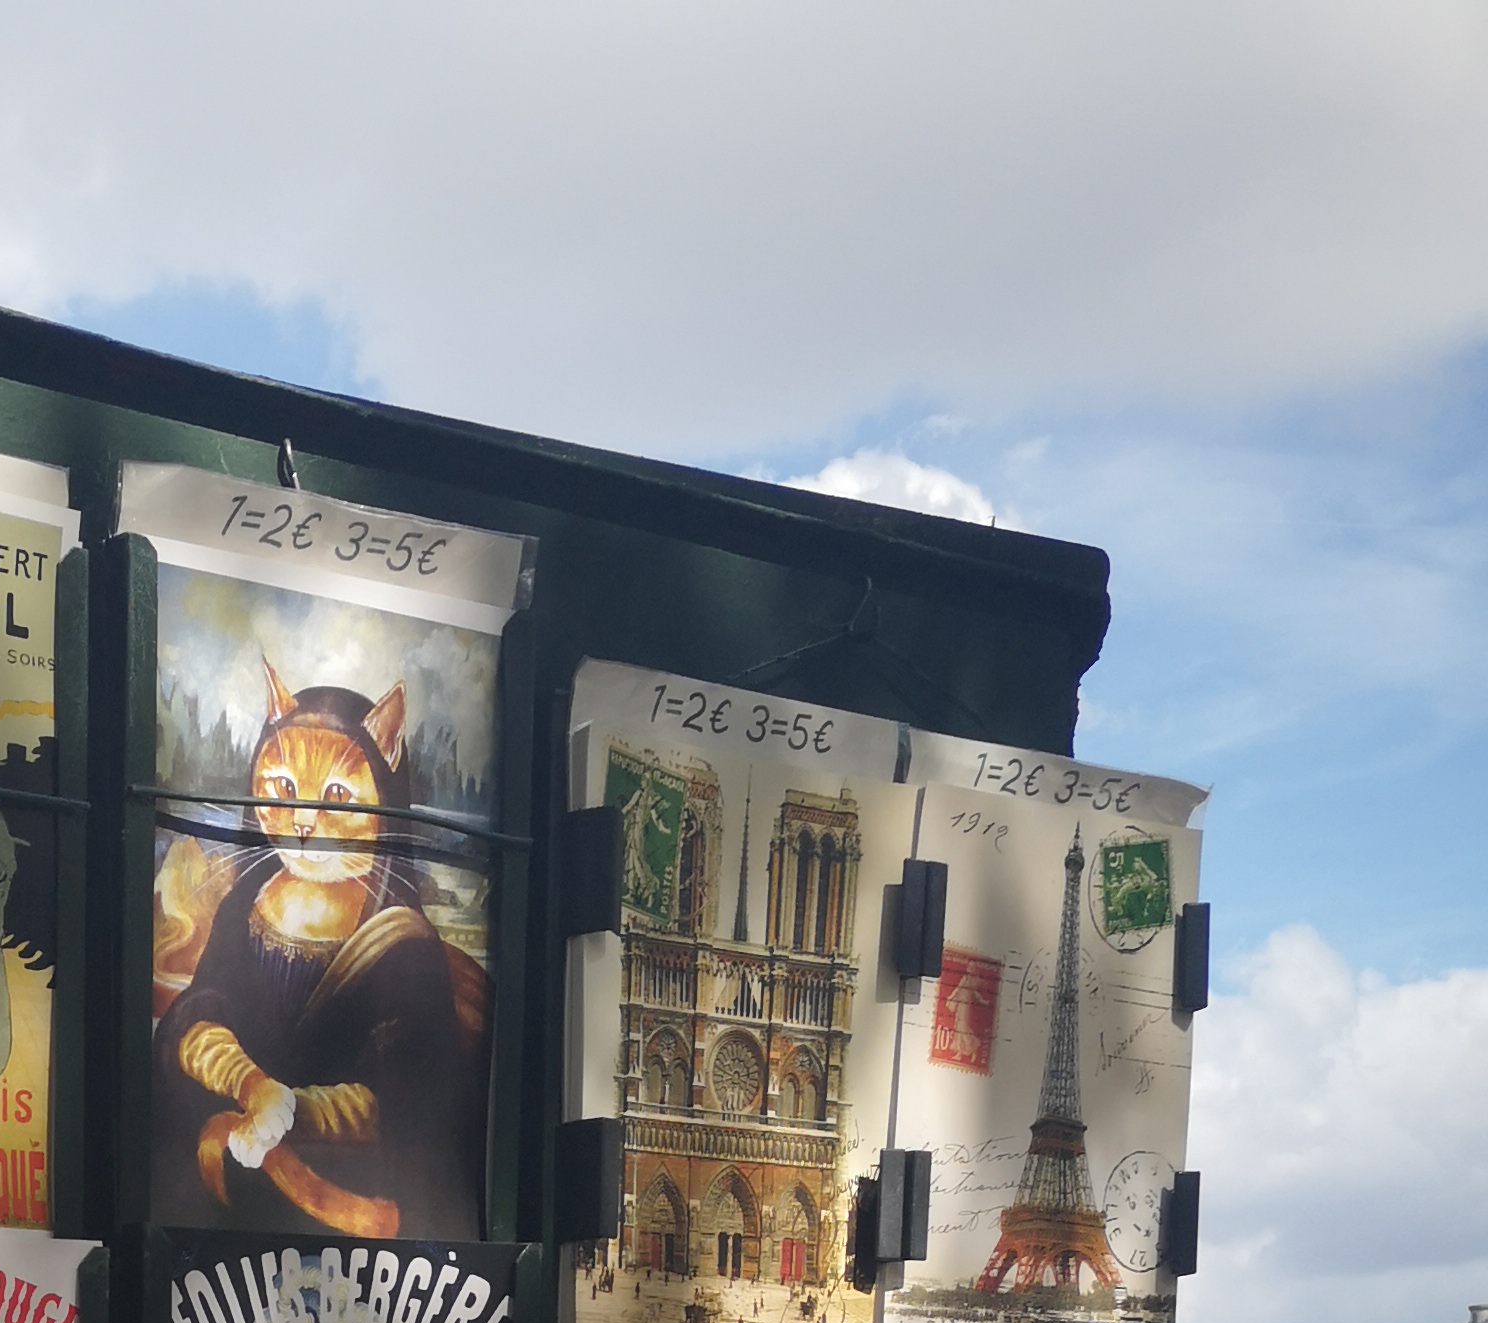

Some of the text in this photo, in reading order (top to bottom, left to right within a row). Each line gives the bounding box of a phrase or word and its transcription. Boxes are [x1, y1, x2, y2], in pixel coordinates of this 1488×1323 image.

[221, 495, 446, 575] 1=2€ 3=5€
[7, 649, 56, 672] SOIRS
[650, 684, 834, 753] 1=2€ 3=5€
[974, 752, 1141, 813] 1=2€ 3=5€
